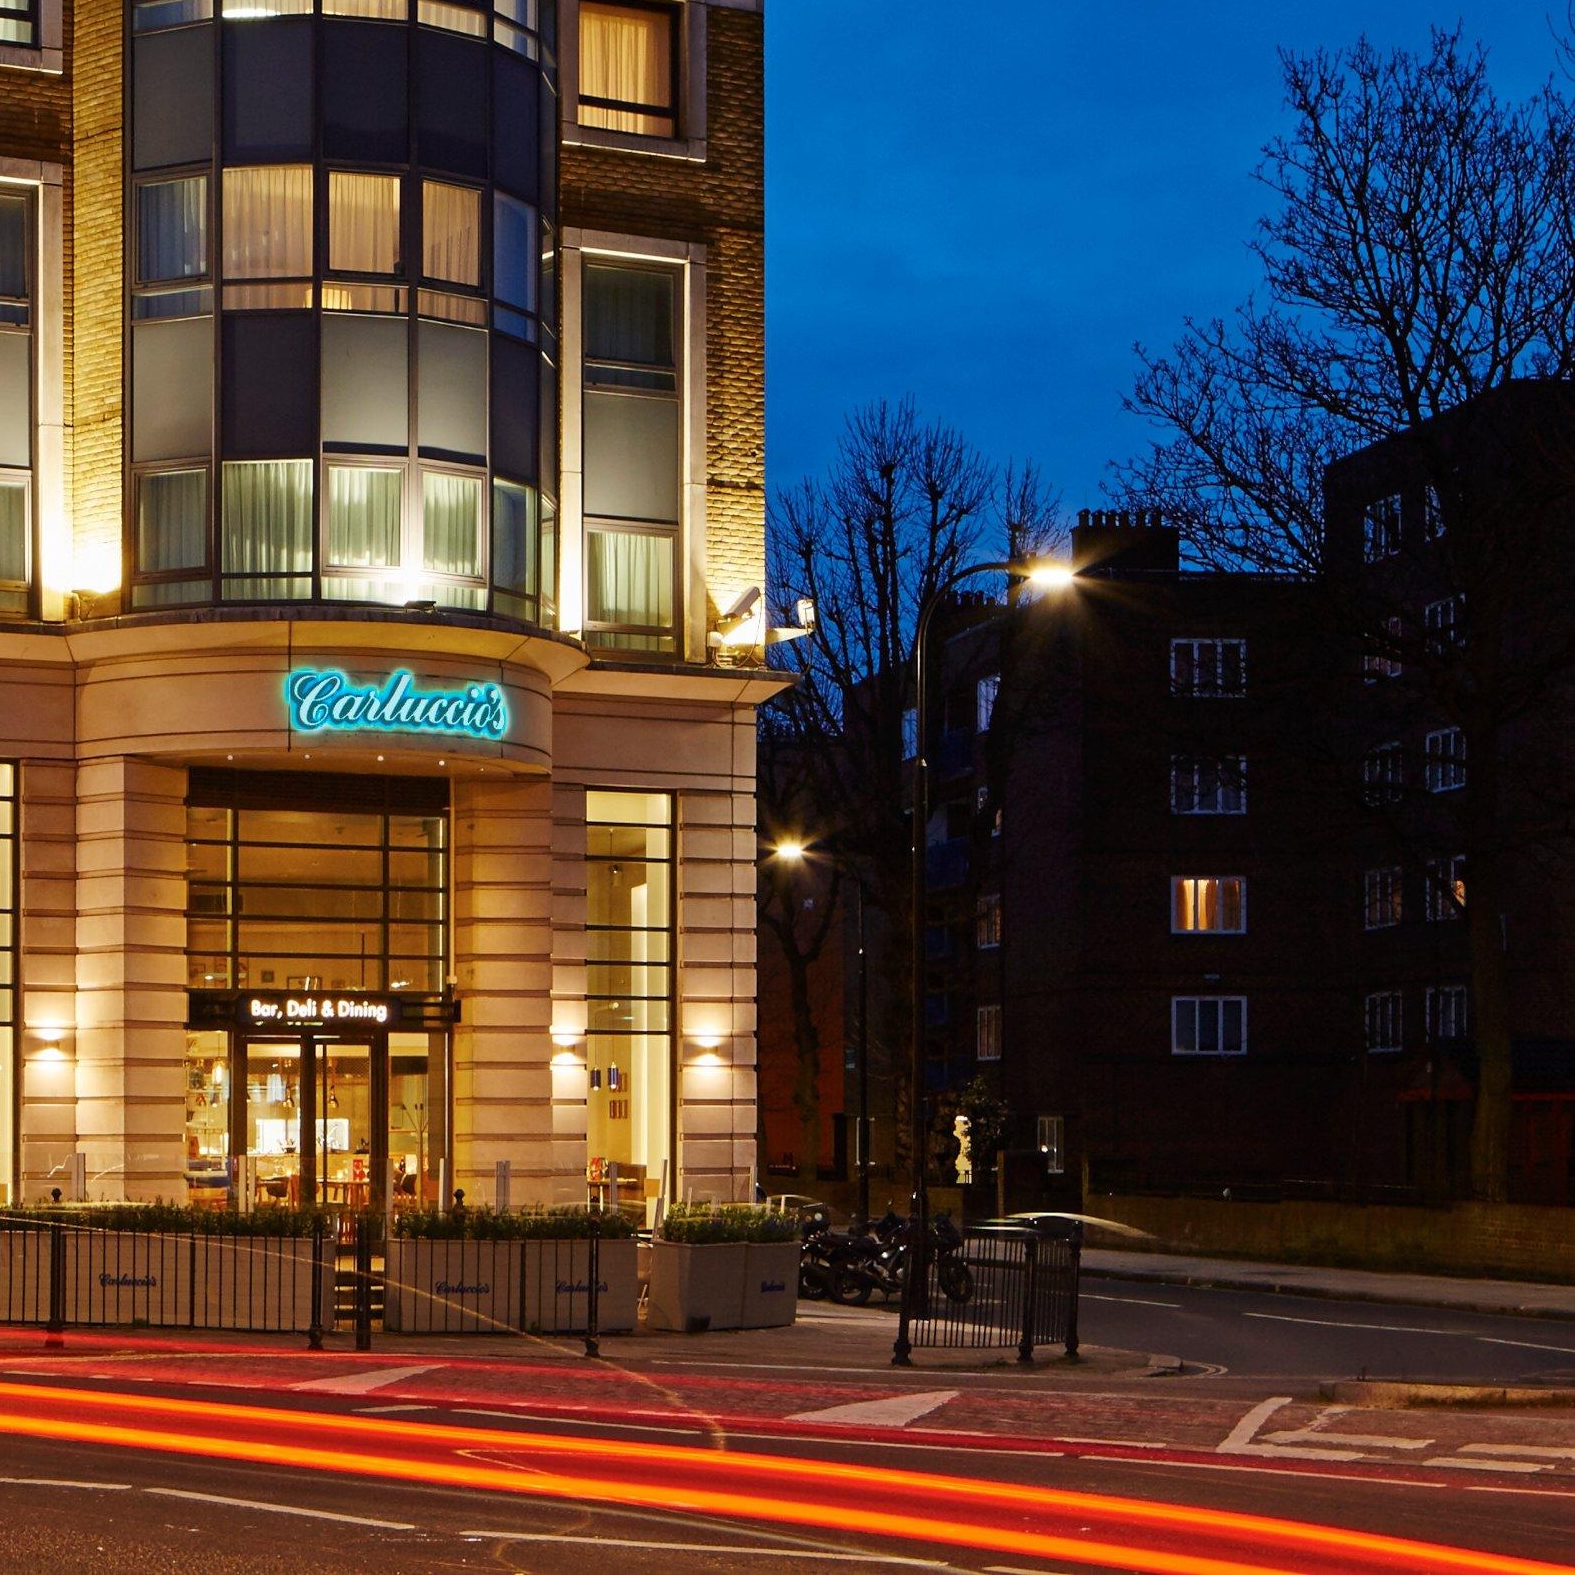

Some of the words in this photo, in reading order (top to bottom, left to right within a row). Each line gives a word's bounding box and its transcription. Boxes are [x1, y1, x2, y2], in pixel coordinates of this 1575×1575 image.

[292, 672, 505, 730] Carluccio's
[251, 999, 284, 1020] Bar,
[287, 998, 317, 1018] Deli
[321, 999, 335, 1018] &
[337, 1000, 388, 1023] Dining
